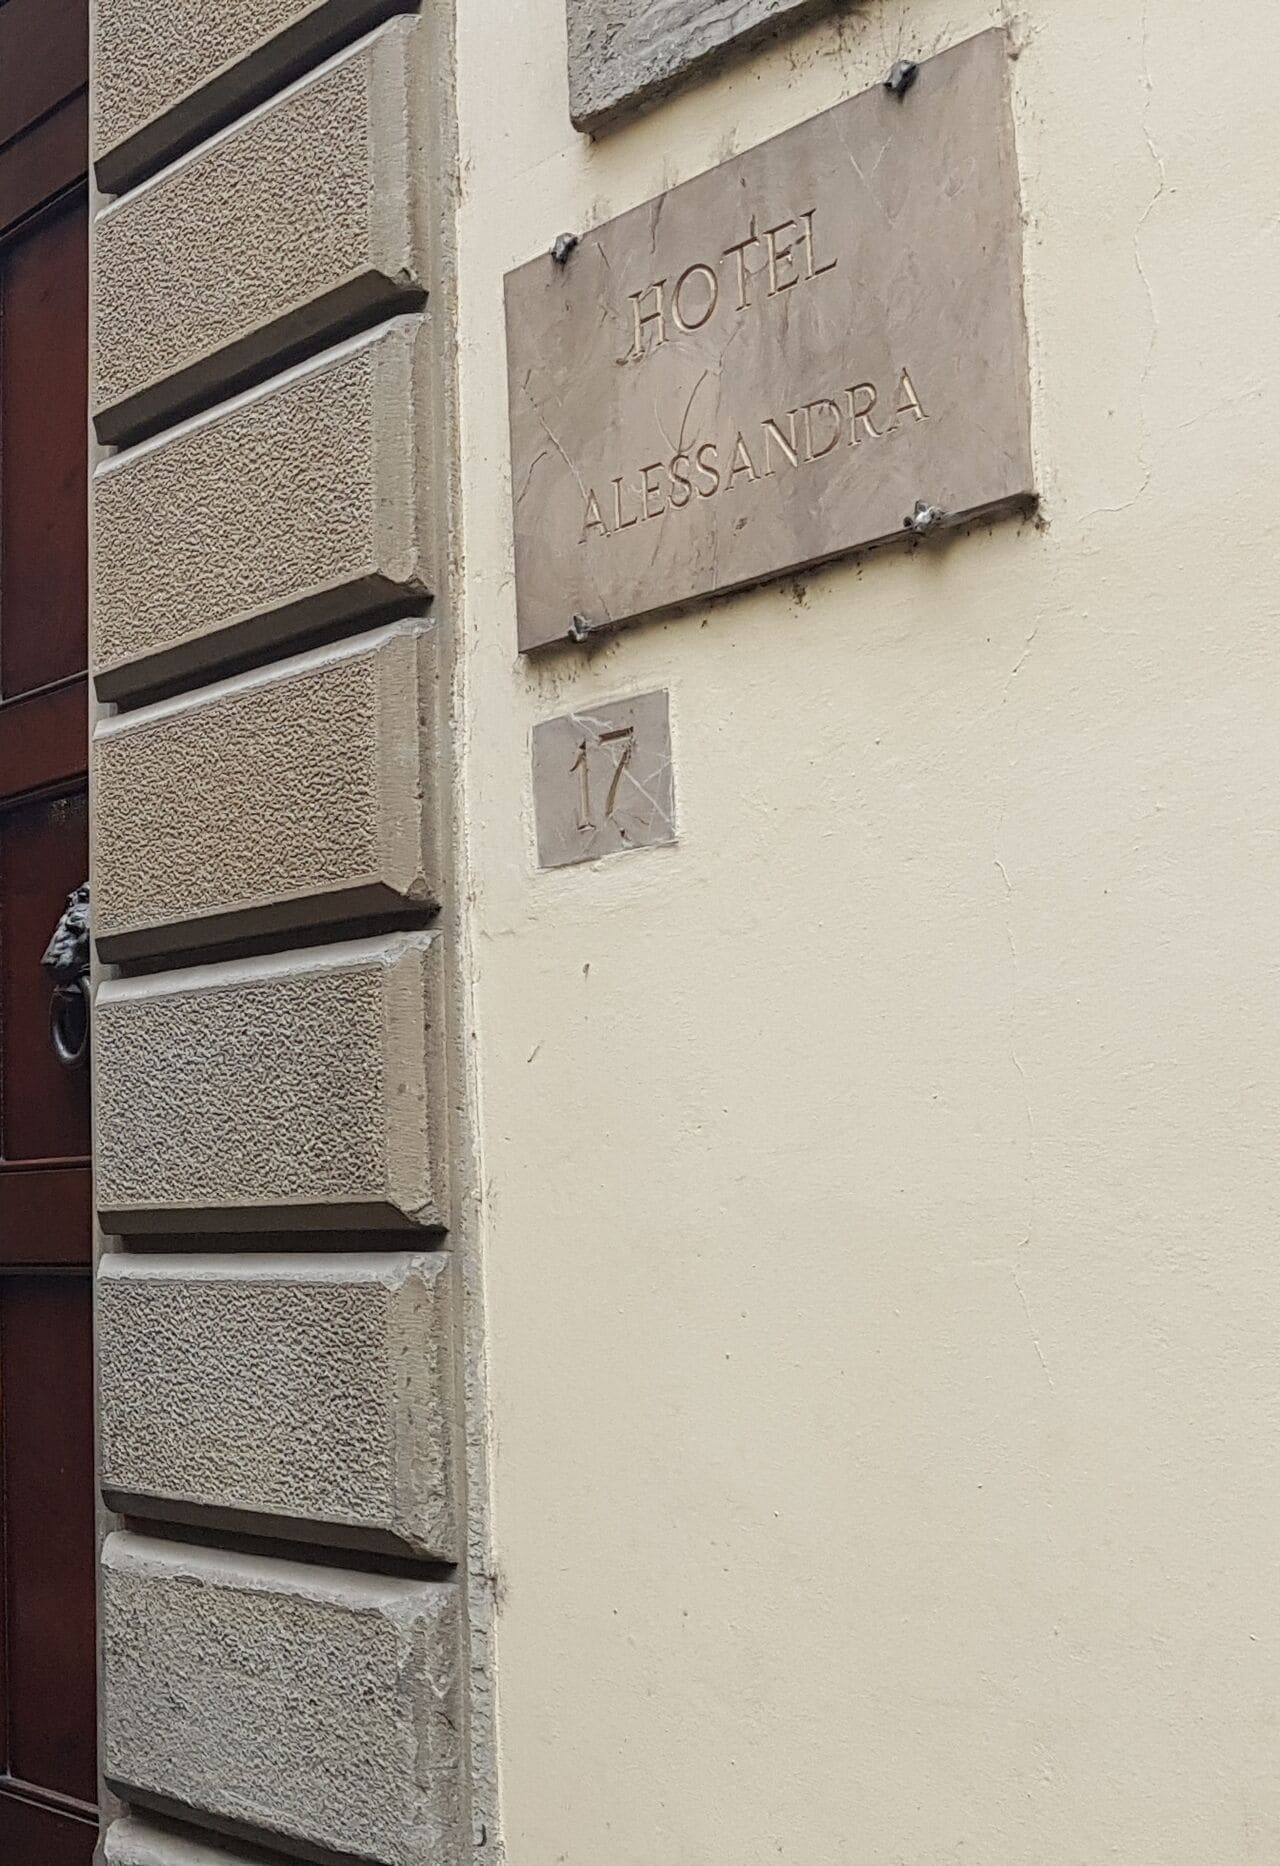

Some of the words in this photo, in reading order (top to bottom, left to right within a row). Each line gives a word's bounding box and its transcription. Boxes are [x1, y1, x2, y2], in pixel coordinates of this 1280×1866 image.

[625, 207, 838, 362] HOTEL
[577, 367, 931, 545] ALESSANDRA
[569, 725, 635, 833] 17
